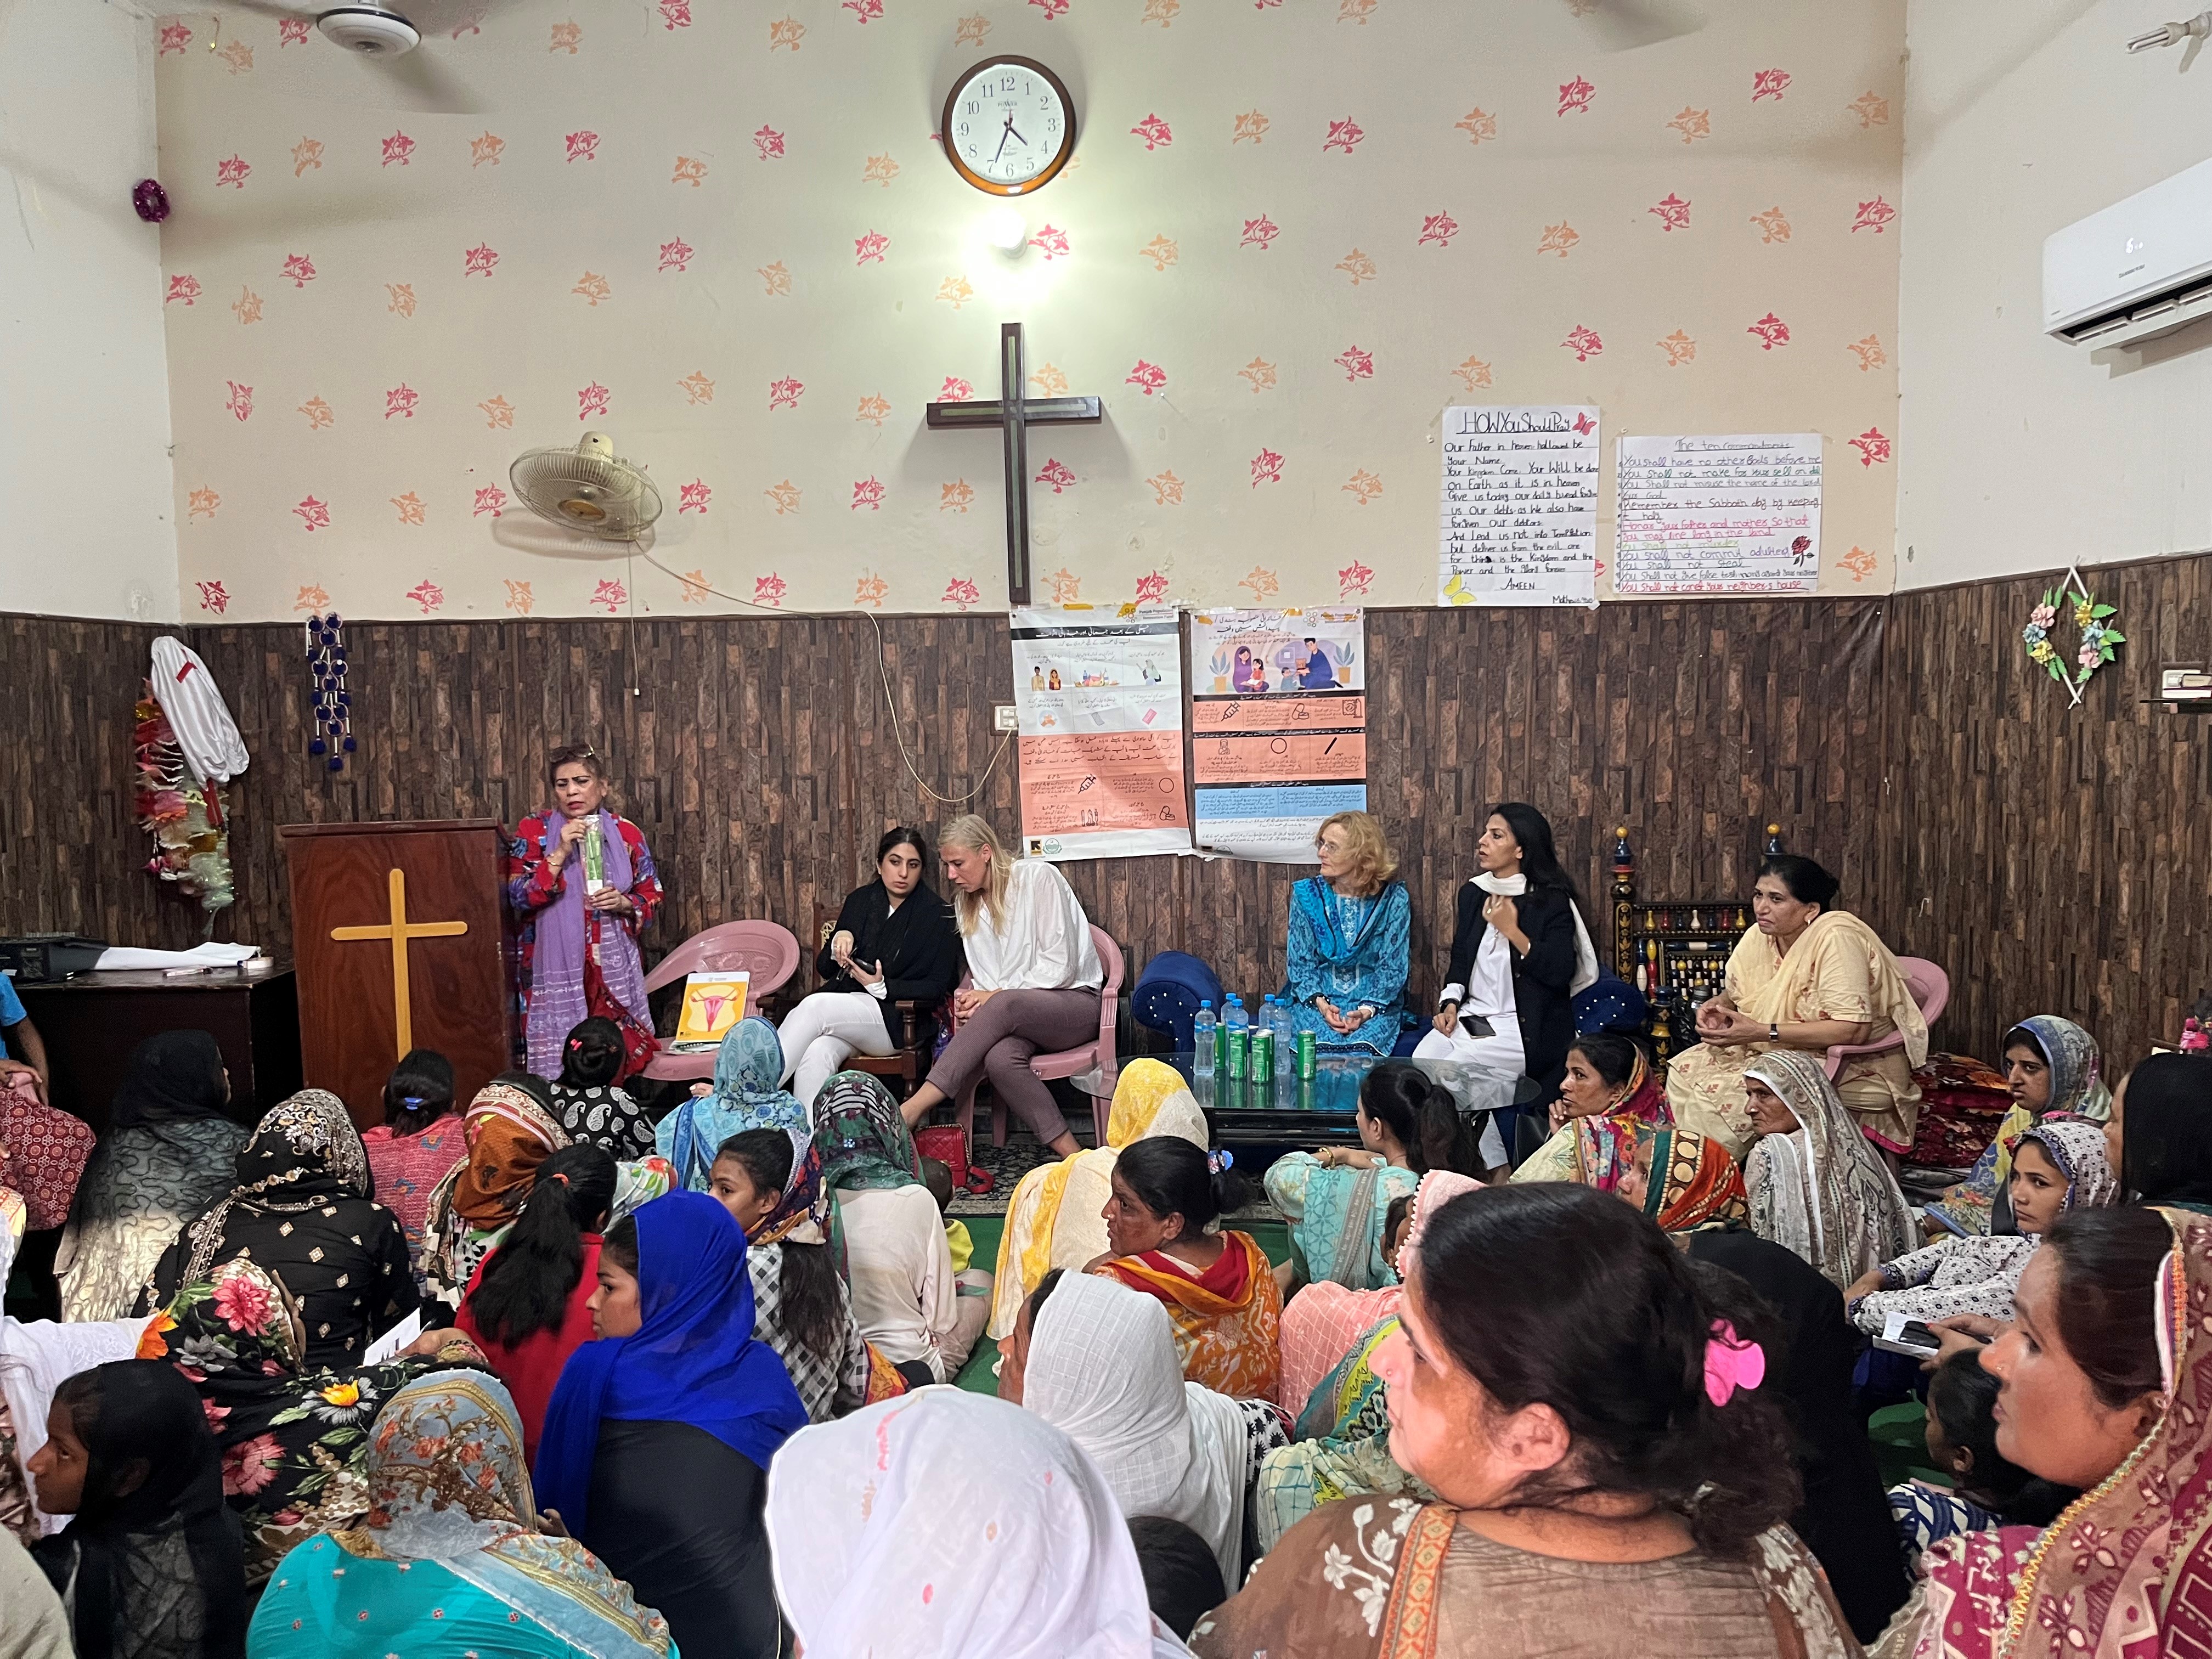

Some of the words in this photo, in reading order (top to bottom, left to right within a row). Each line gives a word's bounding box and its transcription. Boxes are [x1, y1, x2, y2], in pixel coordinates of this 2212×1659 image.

[1000, 76, 1015, 91] 12
[1025, 81, 1030, 95] 1
[981, 83, 994, 98] 11
[967, 101, 980, 115] 10
[1040, 96, 1049, 110] 2
[961, 122, 969, 137] 9
[1048, 118, 1056, 132] 3
[969, 144, 978, 158] 8
[1040, 140, 1048, 154] 4
[986, 160, 995, 173] 7
[1006, 163, 1014, 177] 6
[1026, 157, 1035, 171] 5
[1444, 442, 1464, 452] Our
[1573, 439, 1583, 448] be
[1675, 436, 1694, 451] The
[1702, 440, 1720, 450] ten
[1448, 455, 1466, 465] Your
[1776, 454, 1805, 464] before
[1447, 466, 1462, 476] Your
[1528, 461, 1544, 473] Your
[1549, 461, 1570, 473] Will
[1575, 462, 1583, 472] be
[1469, 478, 1492, 489] Earth
[1515, 478, 1523, 488] it
[1531, 479, 1539, 487] is
[1728, 478, 1741, 487] the
[1771, 478, 1779, 487] of
[1783, 478, 1798, 487] the
[1448, 491, 1467, 501] Give
[1487, 491, 1509, 502] today
[1451, 507, 1462, 515] us
[1547, 503, 1564, 513] also
[1685, 499, 1702, 509] the
[1513, 531, 1528, 539] not
[1451, 543, 1465, 553] but
[1533, 543, 1544, 551] the
[1450, 555, 1463, 563] for
[1511, 553, 1522, 562] the
[1582, 552, 1593, 560] the
[1504, 565, 1515, 573] the
[1500, 578, 1535, 590] AMEEN
